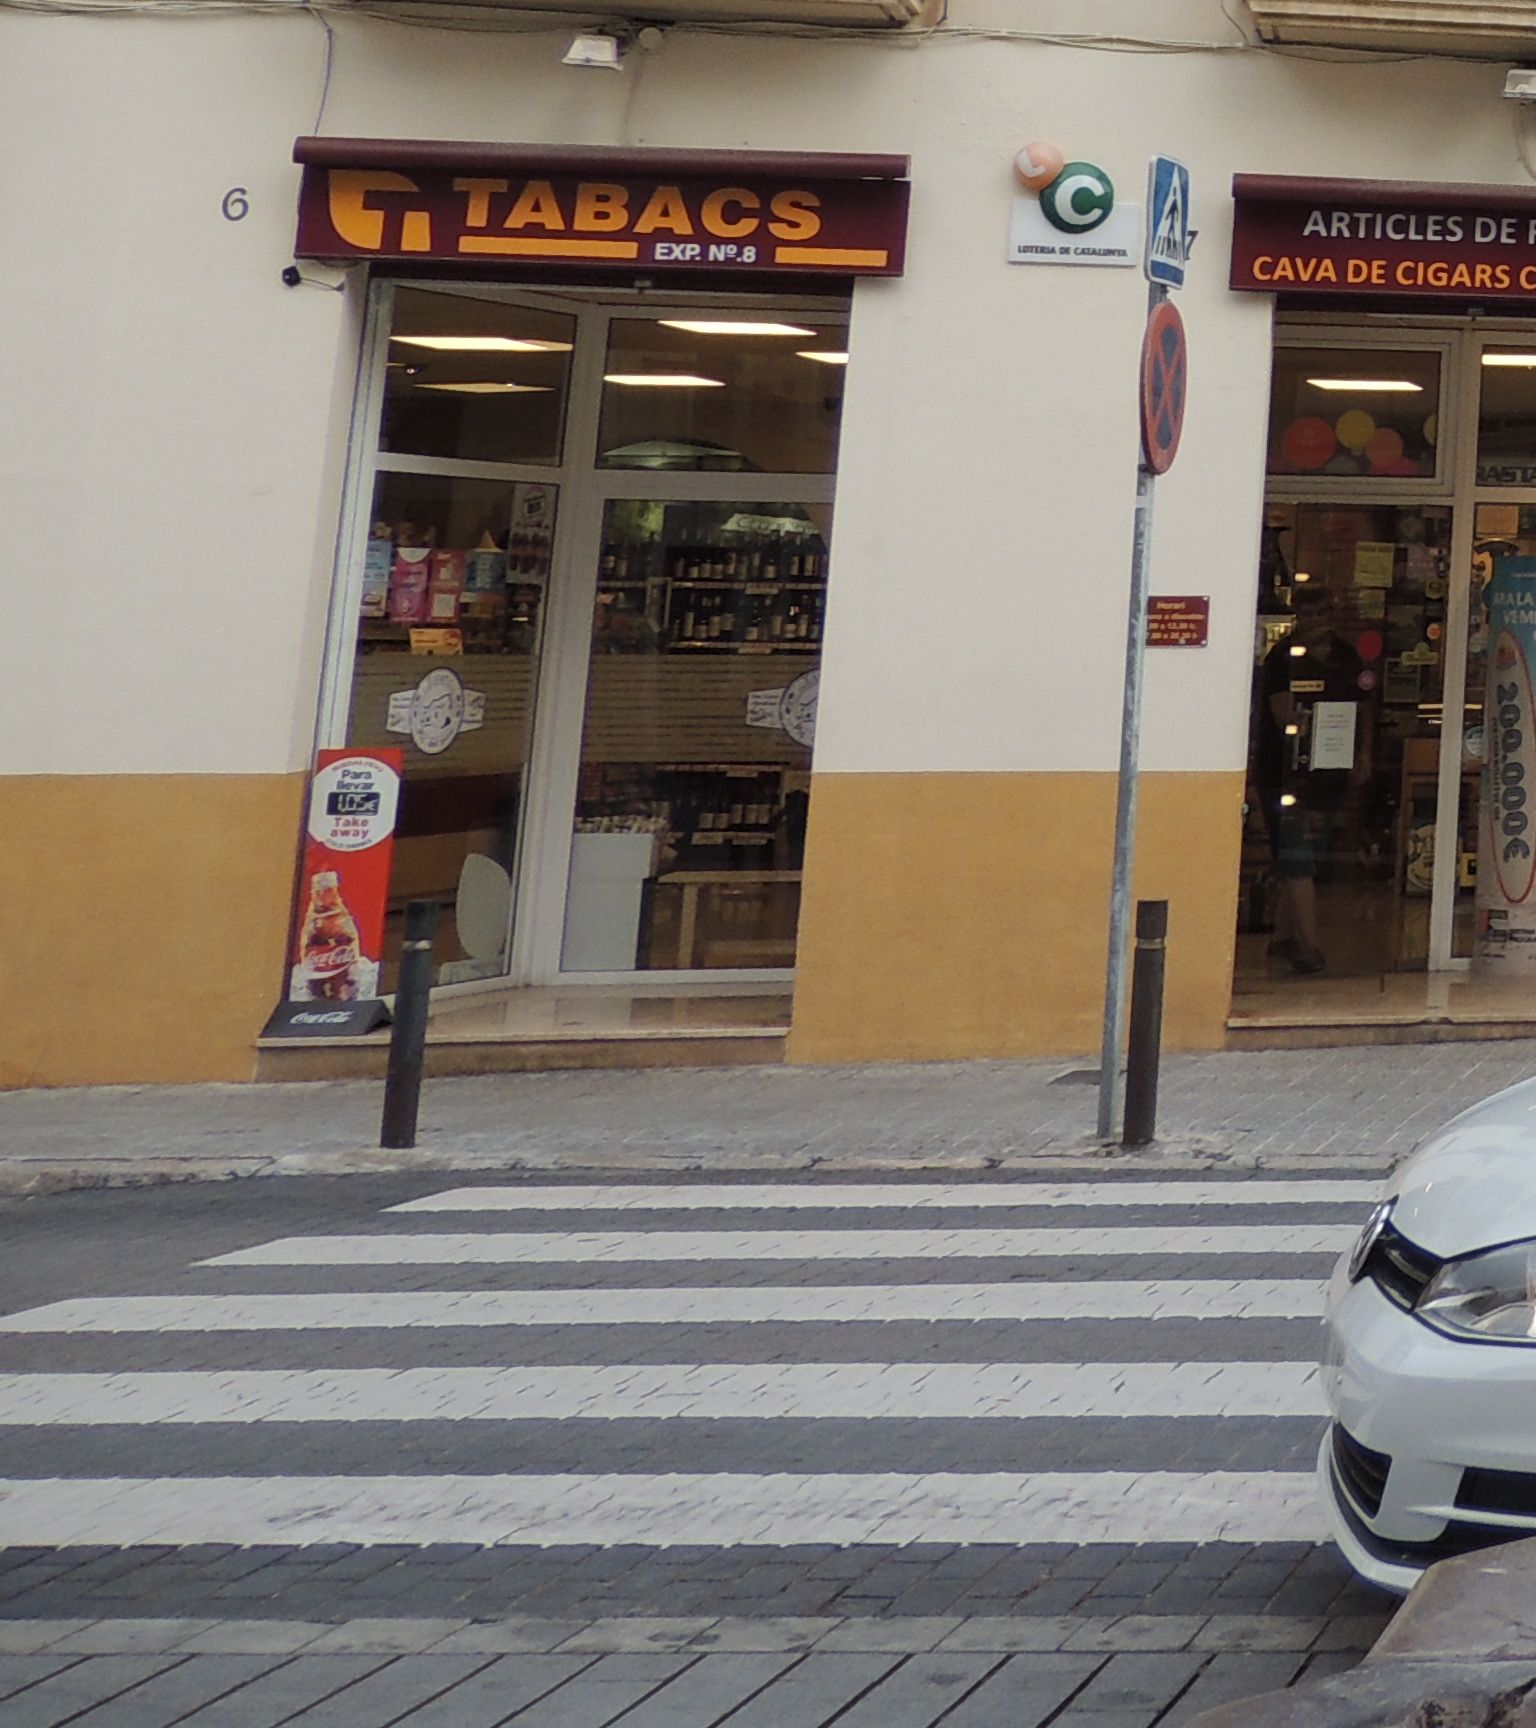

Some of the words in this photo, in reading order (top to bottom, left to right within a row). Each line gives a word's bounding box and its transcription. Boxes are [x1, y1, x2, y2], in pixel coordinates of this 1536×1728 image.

[221, 186, 250, 222] 6
[453, 177, 821, 242] TABACS
[1054, 174, 1105, 226] C
[1302, 209, 1464, 243] ARTICLES
[1474, 216, 1518, 245] DE
[654, 242, 701, 261] EXP.
[1017, 244, 1057, 255] LOTERIA
[1058, 246, 1072, 256] DE
[1074, 246, 1129, 258] CATALUNYA
[1252, 255, 1338, 283] CAVA
[1346, 258, 1388, 284] DE
[1395, 260, 1512, 289] CIGARS
[1517, 591, 1534, 606] LA
[1502, 610, 1518, 625] VE
[341, 768, 372, 780] Para
[1497, 681, 1530, 863] 200.000€
[334, 817, 369, 827] Take
[330, 829, 369, 839] away
